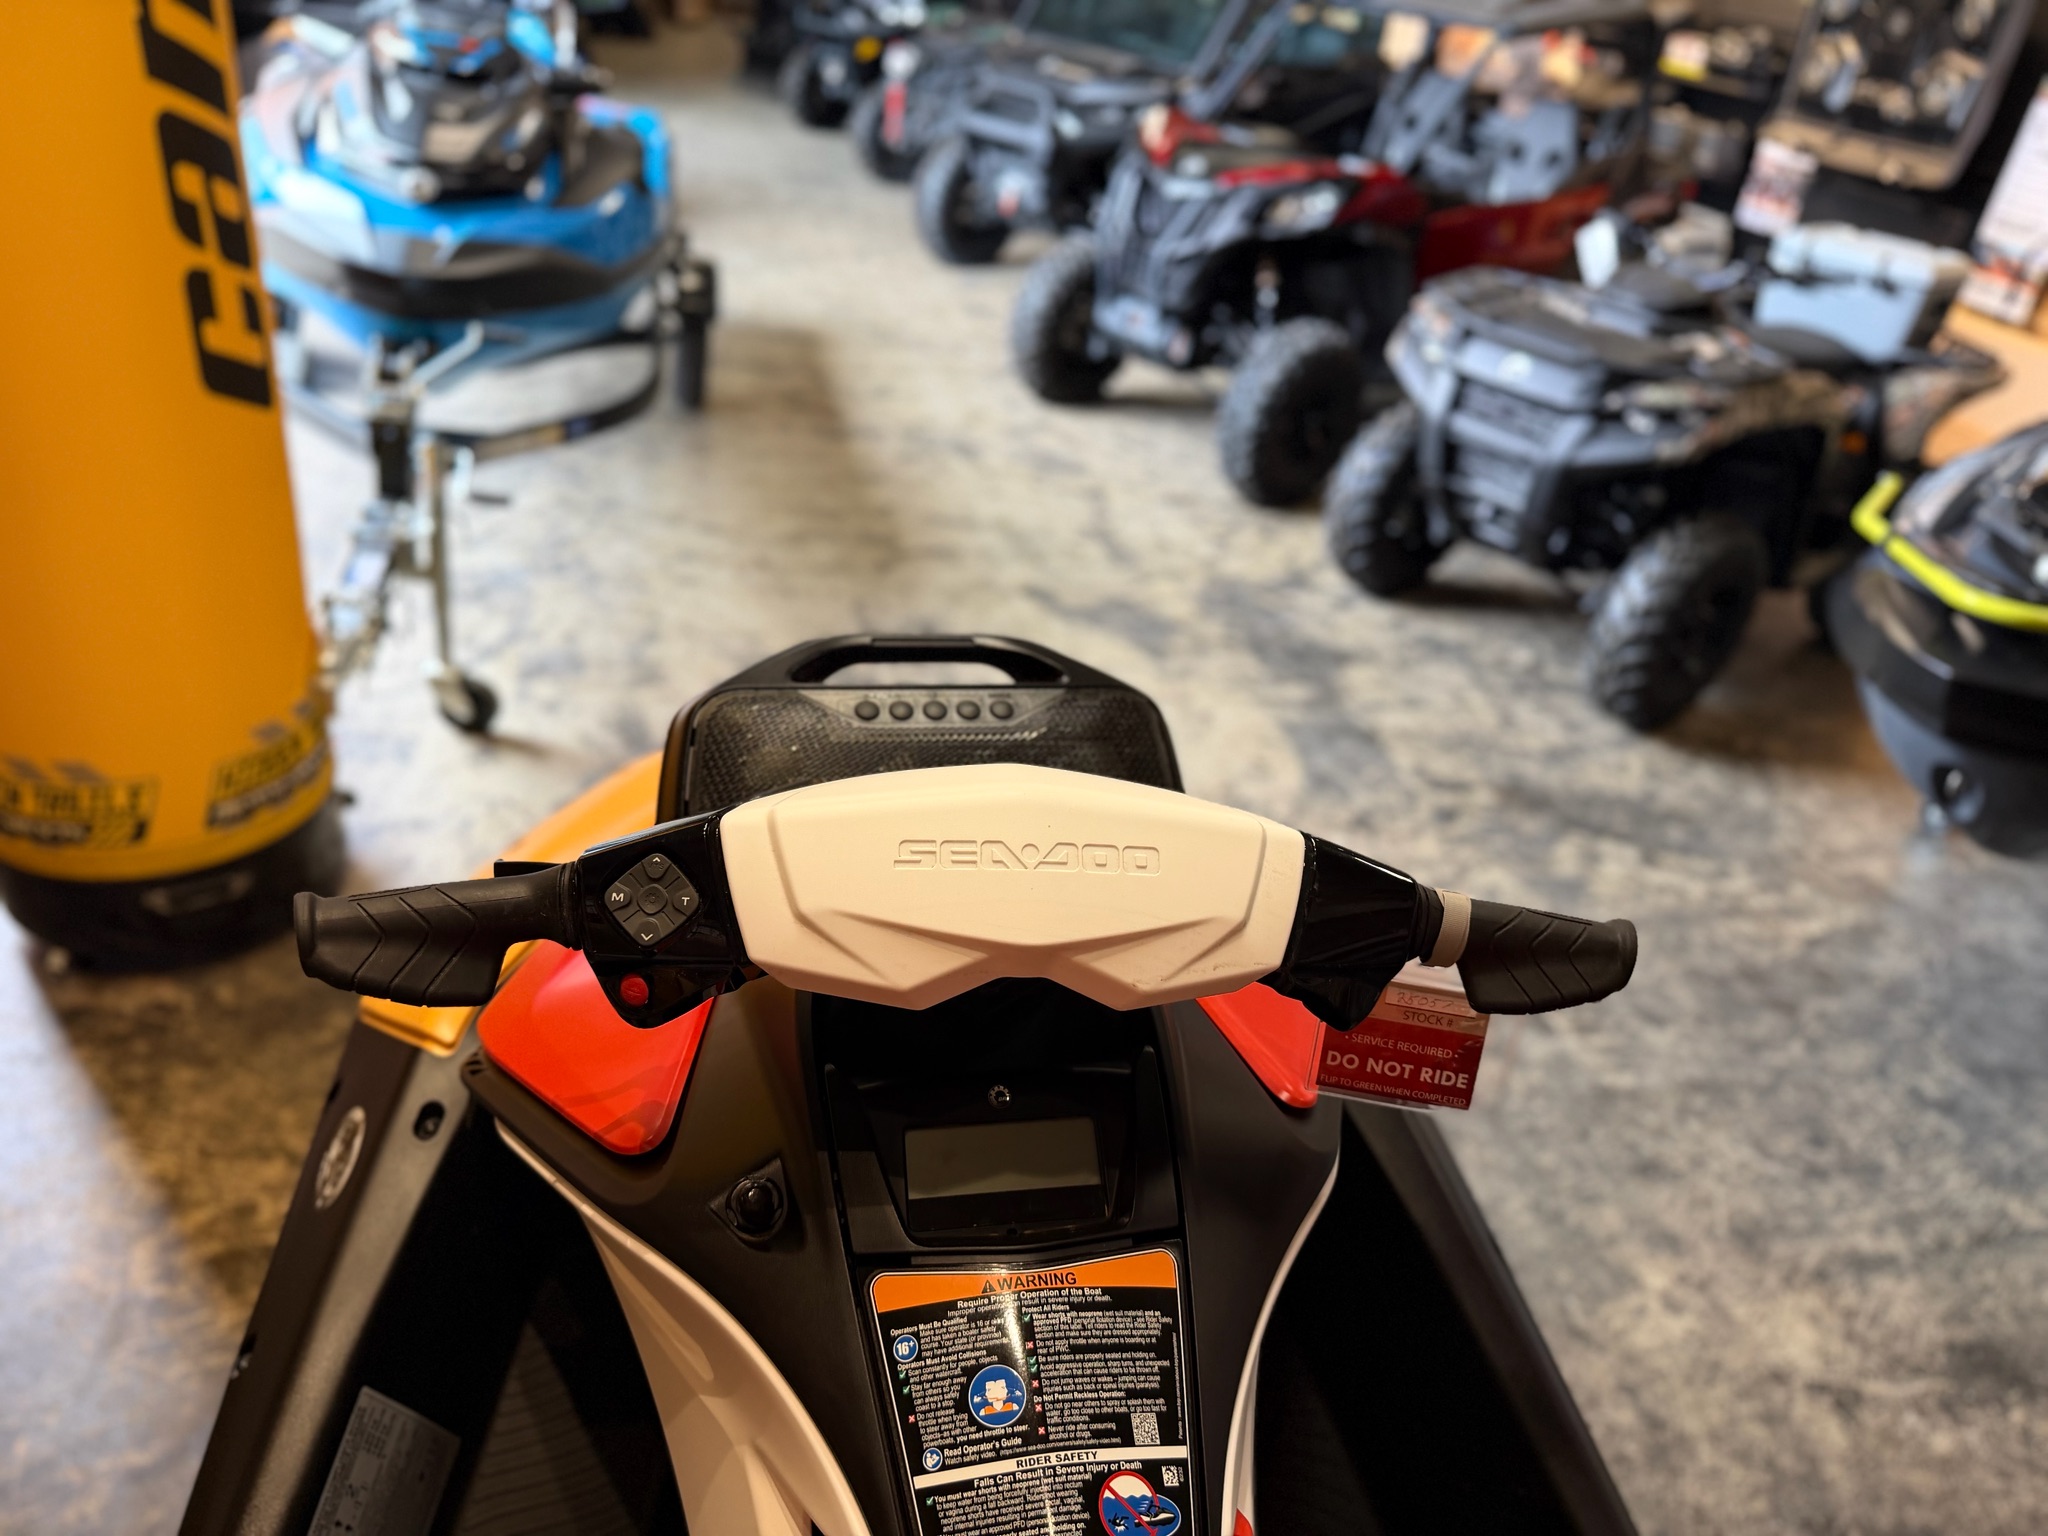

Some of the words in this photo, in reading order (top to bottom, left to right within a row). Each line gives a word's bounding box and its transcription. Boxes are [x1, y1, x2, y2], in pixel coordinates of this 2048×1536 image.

[611, 892, 625, 903] M
[681, 897, 691, 906] T
[1403, 1011, 1443, 1026] STOCK
[1446, 1019, 1454, 1028] #
[1352, 1033, 1395, 1049] SERVICE
[1397, 1041, 1453, 1059] REQUIRED
[1326, 1050, 1360, 1070] DO
[1366, 1057, 1415, 1079] NOT
[1419, 1066, 1469, 1089] RIDE
[1320, 1074, 1338, 1084] FLIP
[1340, 1078, 1351, 1087] TO
[1352, 1080, 1382, 1093] GREEN
[1383, 1085, 1411, 1097] WHEN
[1411, 1090, 1466, 1106] COMPLETED
[996, 1272, 1077, 1291] WARNING
[957, 1297, 988, 1308] Require
[1020, 1289, 1059, 1300] Operation
[1061, 1287, 1068, 1296] of
[1070, 1287, 1082, 1295] the
[1084, 1286, 1101, 1295] Boat
[947, 1307, 976, 1317] Improper
[1021, 1305, 1042, 1313] Protect
[1043, 1304, 1051, 1312] All
[890, 1326, 918, 1337] Operators
[919, 1323, 933, 1331] Must
[942, 1316, 967, 1327] Qualified
[897, 1361, 925, 1371] Operators
[926, 1357, 940, 1366] Must
[941, 1354, 958, 1363] Avoid
[958, 1350, 987, 1360] Collisions
[1054, 1393, 1073, 1401] Permit
[1099, 1390, 1125, 1399] Operation:
[944, 1446, 962, 1457] Read
[963, 1440, 1000, 1455] Operator's
[1001, 1437, 1022, 1447] Guide
[1016, 1453, 1052, 1469] RIDER
[1055, 1450, 1098, 1463] SAFETY
[974, 1477, 994, 1488] Falls
[996, 1474, 1013, 1483] Can
[1015, 1468, 1043, 1479] Result
[1045, 1467, 1053, 1475] in
[1055, 1464, 1084, 1474] Severe
[1086, 1462, 1108, 1472] Injury
[1120, 1460, 1142, 1469] Death
